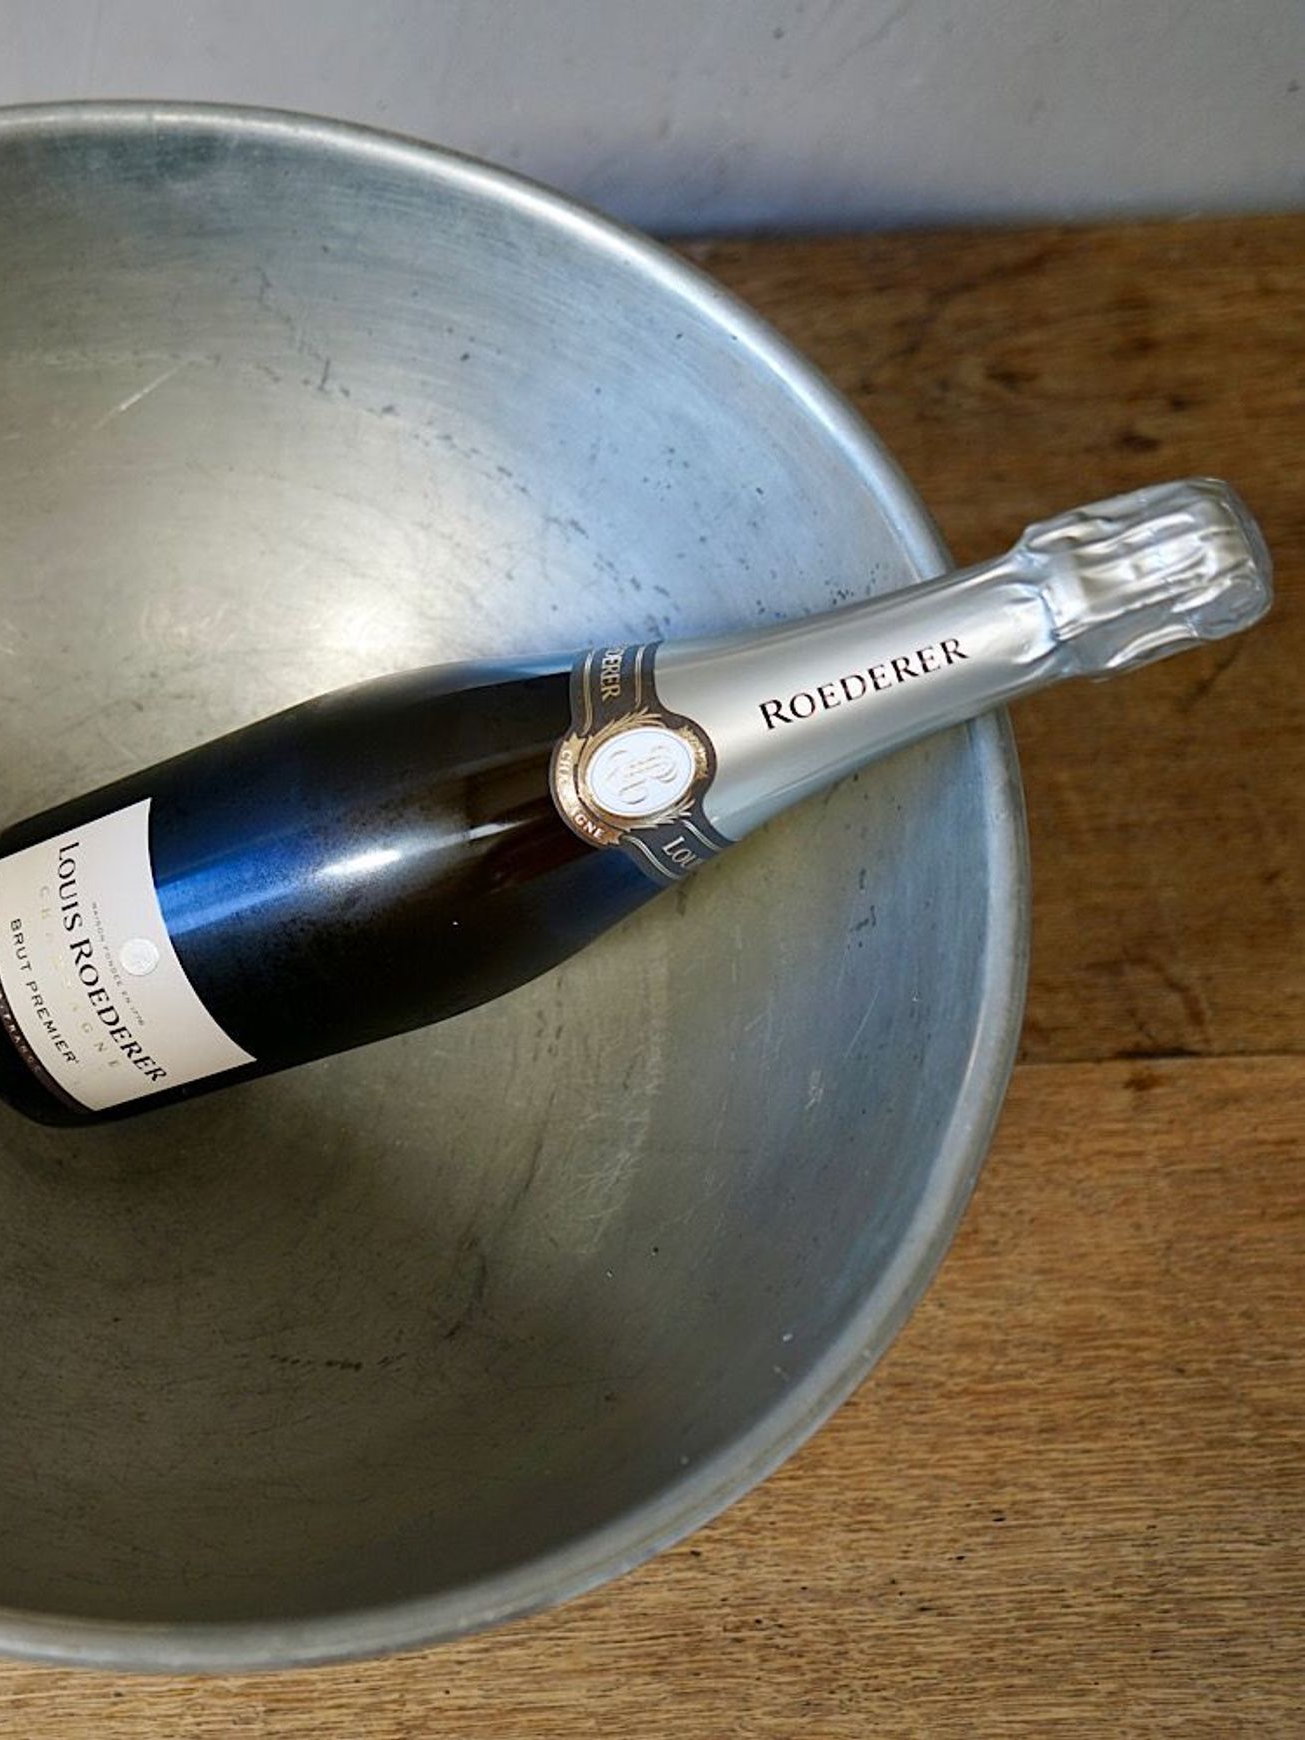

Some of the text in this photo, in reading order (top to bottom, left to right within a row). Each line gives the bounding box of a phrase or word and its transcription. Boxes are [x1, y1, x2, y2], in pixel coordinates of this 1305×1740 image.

[759, 638, 970, 730] ROEDERER
[10, 918, 78, 1064] BRUT PREMIER
[58, 841, 168, 1083] LOUIS ROEDERER
